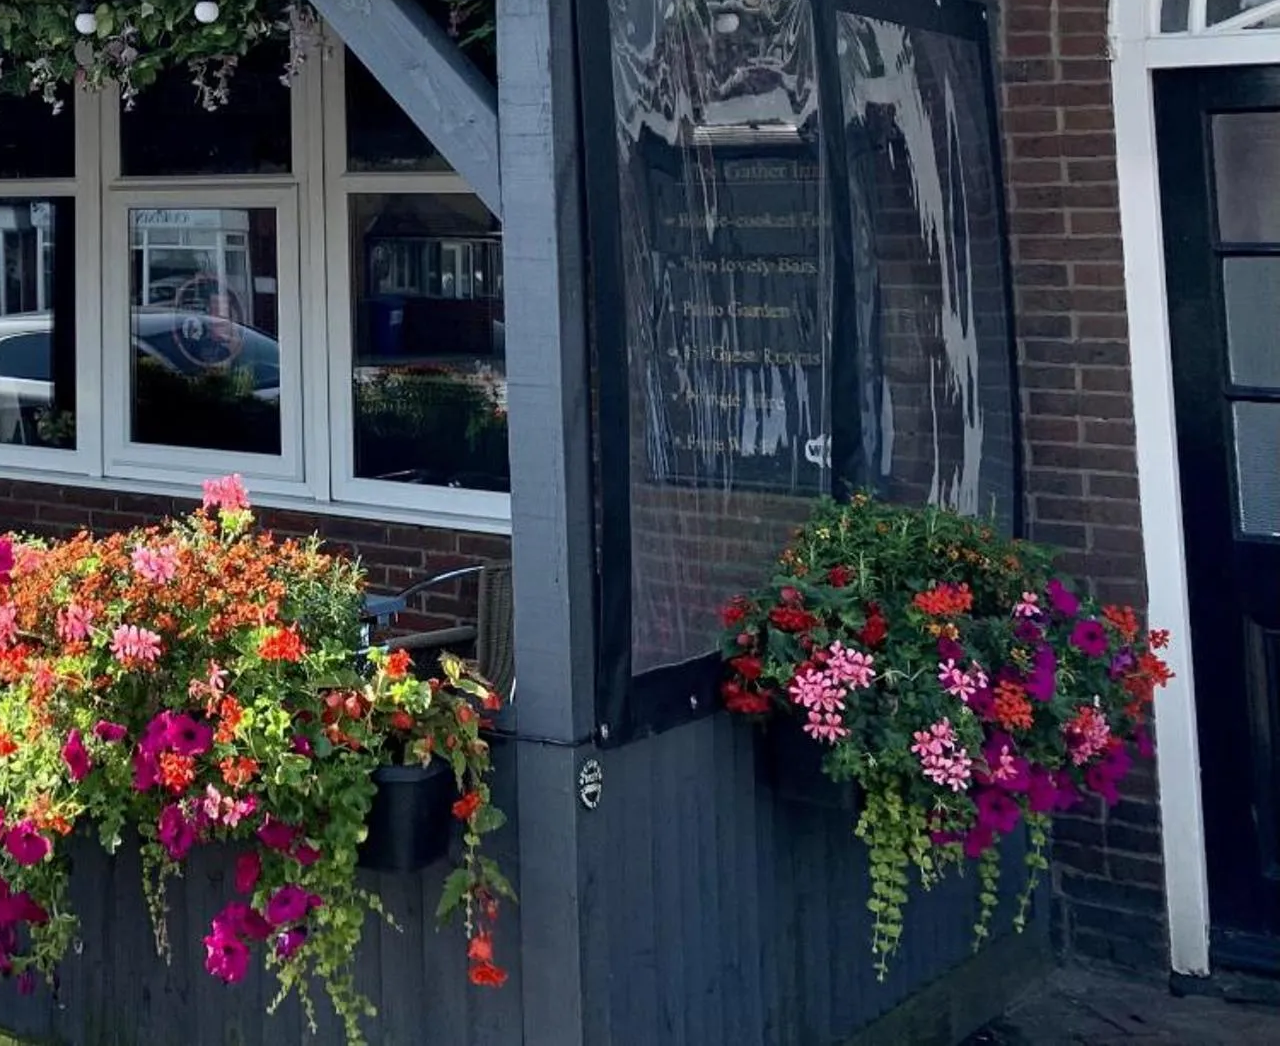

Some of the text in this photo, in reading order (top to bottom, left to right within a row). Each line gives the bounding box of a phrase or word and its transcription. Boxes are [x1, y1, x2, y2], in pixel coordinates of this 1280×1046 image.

[723, 160, 788, 180] Gather
[721, 256, 770, 277] lovely
[777, 257, 819, 275] Bars
[727, 300, 791, 318] Garden
[764, 346, 821, 365] Rooms
